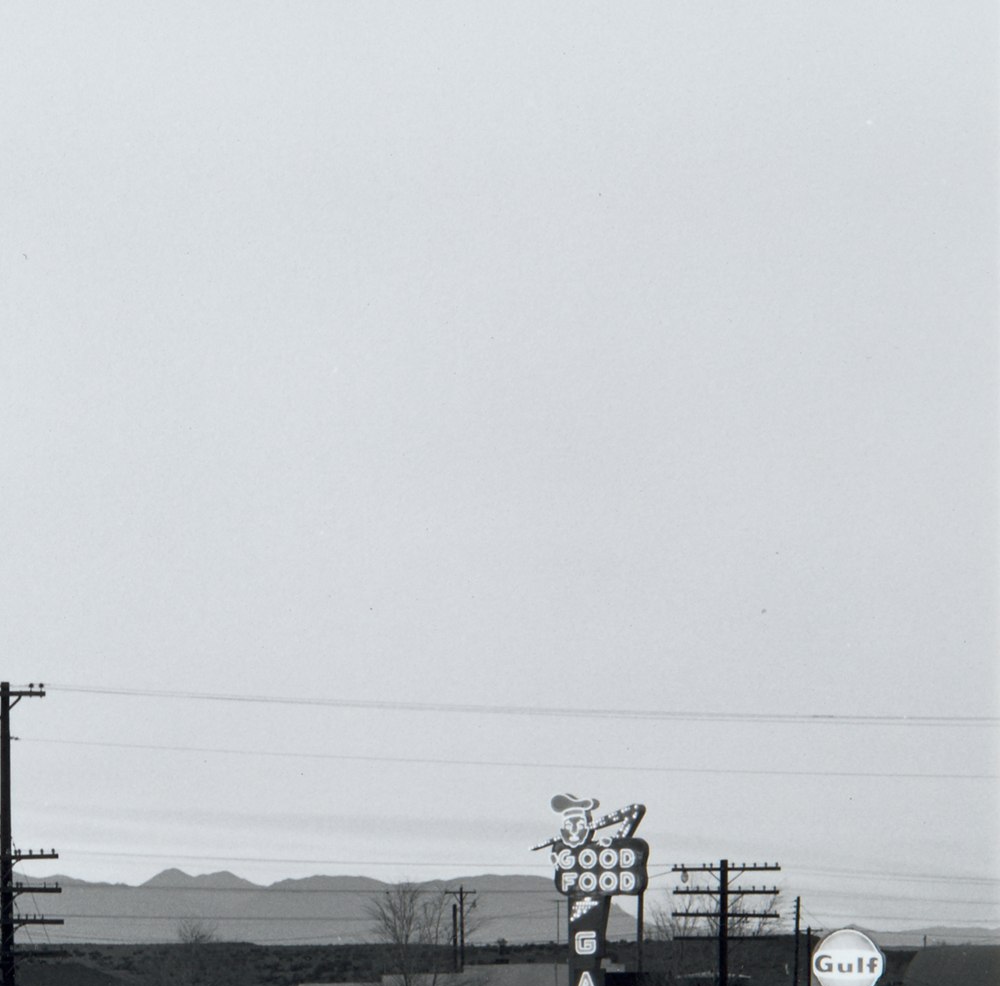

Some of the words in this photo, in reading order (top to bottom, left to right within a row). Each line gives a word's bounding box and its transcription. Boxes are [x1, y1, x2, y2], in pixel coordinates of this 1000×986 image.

[558, 848, 636, 870] GOOD
[561, 871, 636, 892] FOOD
[814, 954, 879, 974] Gulf
